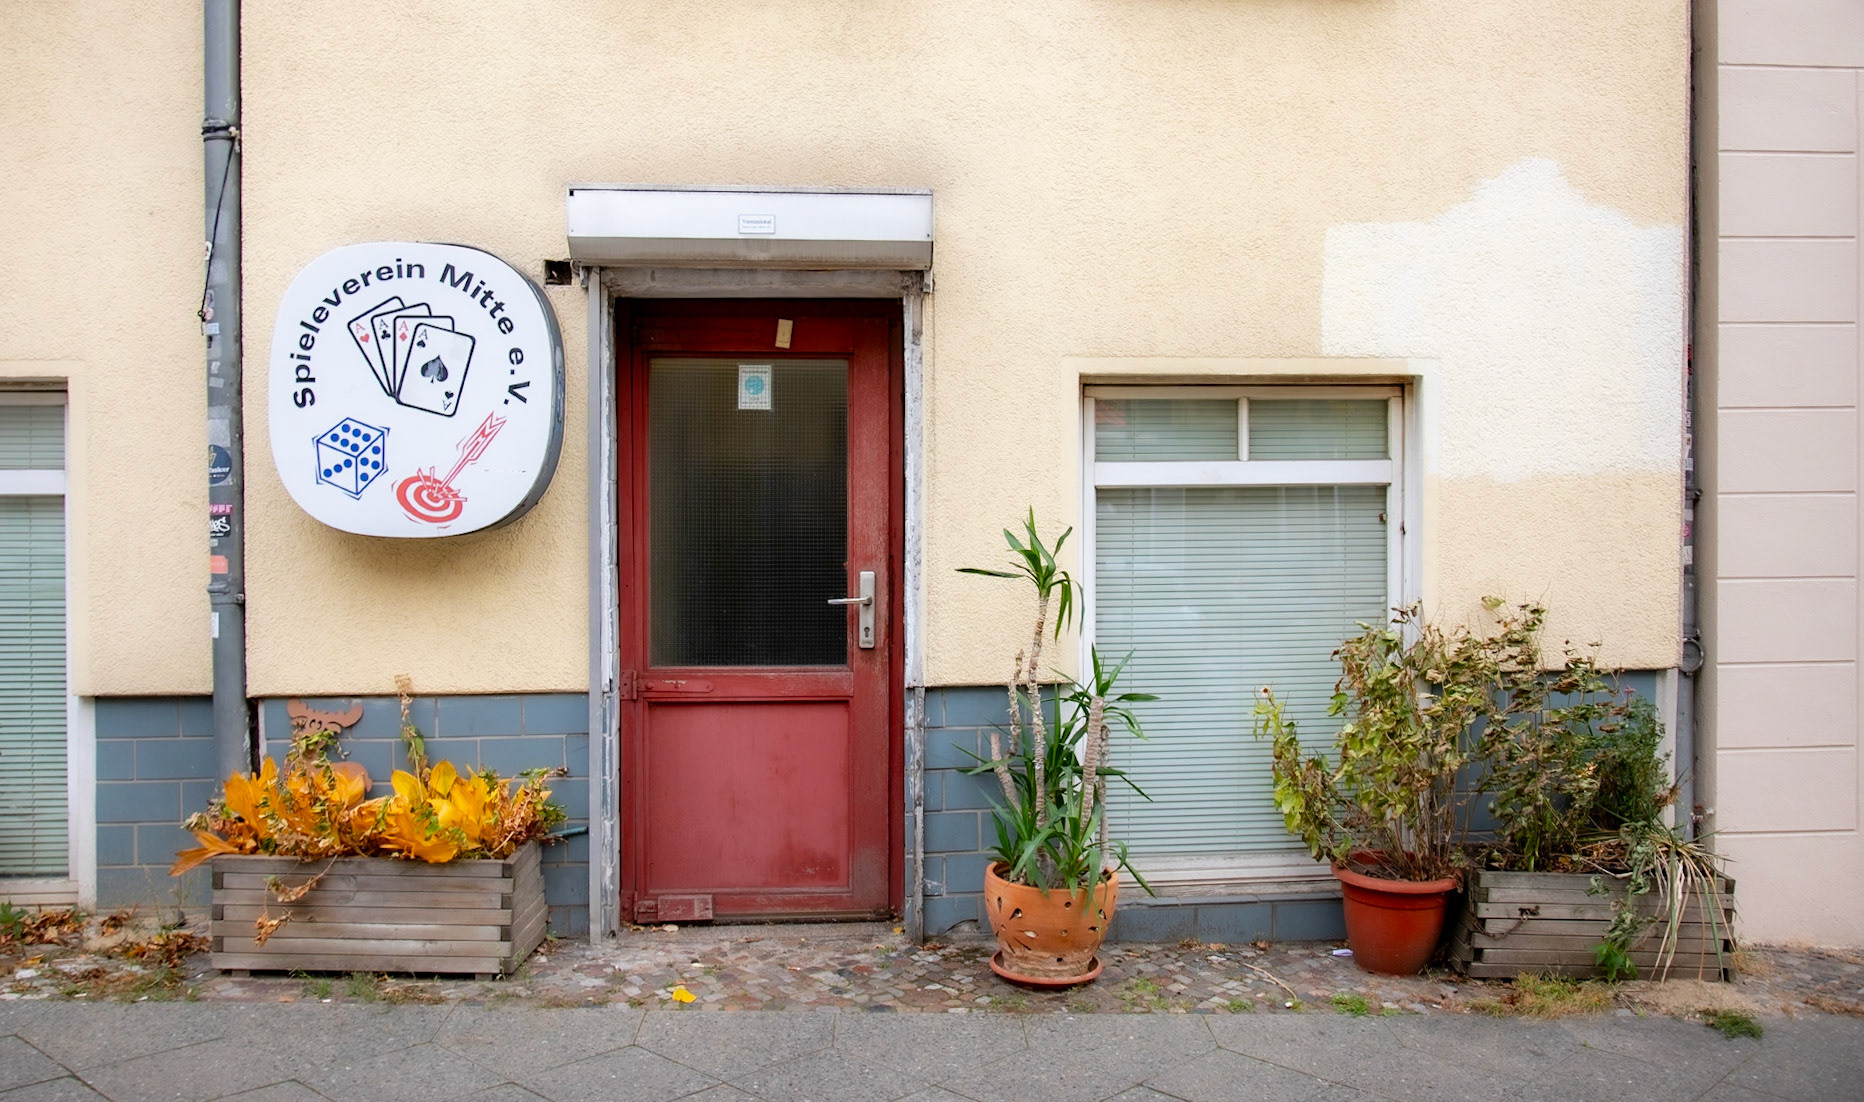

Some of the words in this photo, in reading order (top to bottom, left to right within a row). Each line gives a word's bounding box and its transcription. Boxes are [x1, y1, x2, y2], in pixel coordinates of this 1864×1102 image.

[355, 322, 366, 333] A
[379, 318, 389, 330] A
[399, 320, 409, 331] A
[290, 258, 425, 408] Spieleverein
[439, 263, 515, 335] Mitte
[503, 347, 531, 405] e.V.
[418, 328, 428, 340] A
[442, 400, 452, 411] A
